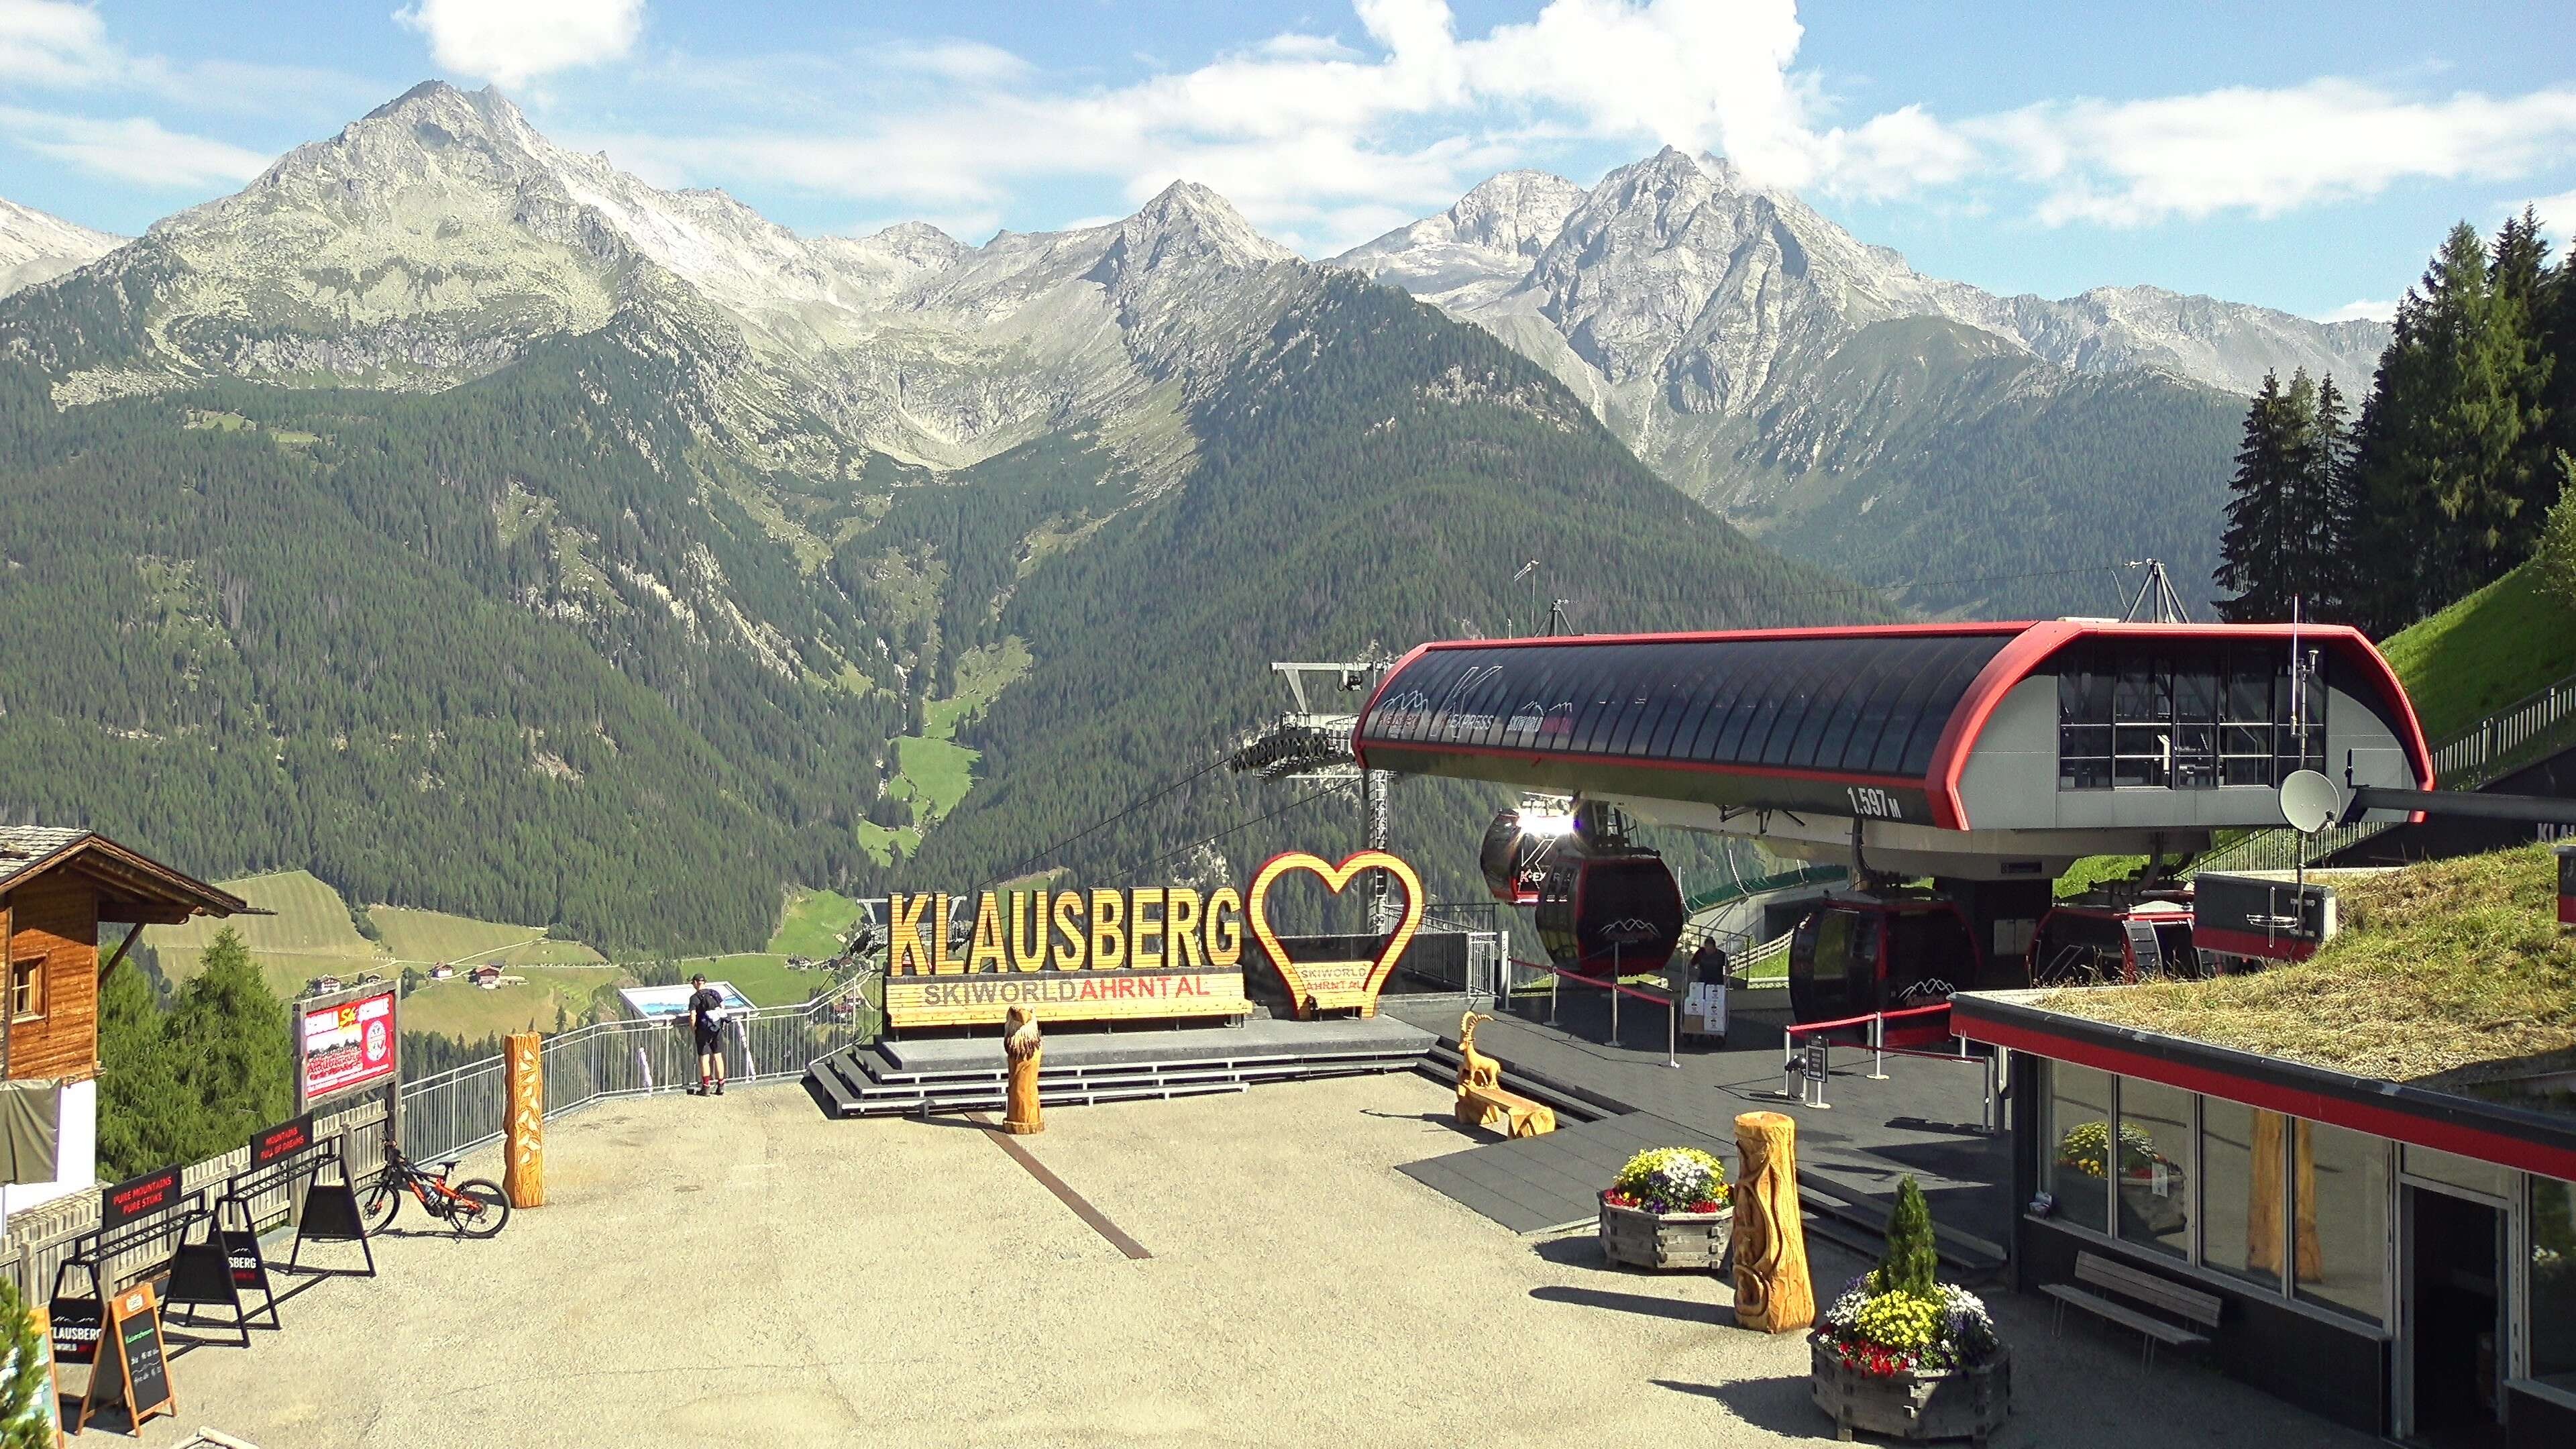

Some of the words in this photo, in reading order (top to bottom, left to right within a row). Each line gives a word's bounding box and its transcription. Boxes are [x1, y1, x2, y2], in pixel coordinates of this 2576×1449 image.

[1847, 787, 1888, 816] 1.597
[1888, 798, 1902, 818] M
[888, 886, 1242, 977] KLAUSBERG
[1301, 968, 1366, 978] SKIWORLD
[1307, 980, 1362, 990] AHRNTAL
[113, 1191, 131, 1205] PURE
[133, 1177, 172, 1197] MOUNTAINS
[142, 1191, 164, 1208] STOKE
[229, 1256, 256, 1269] SBERG
